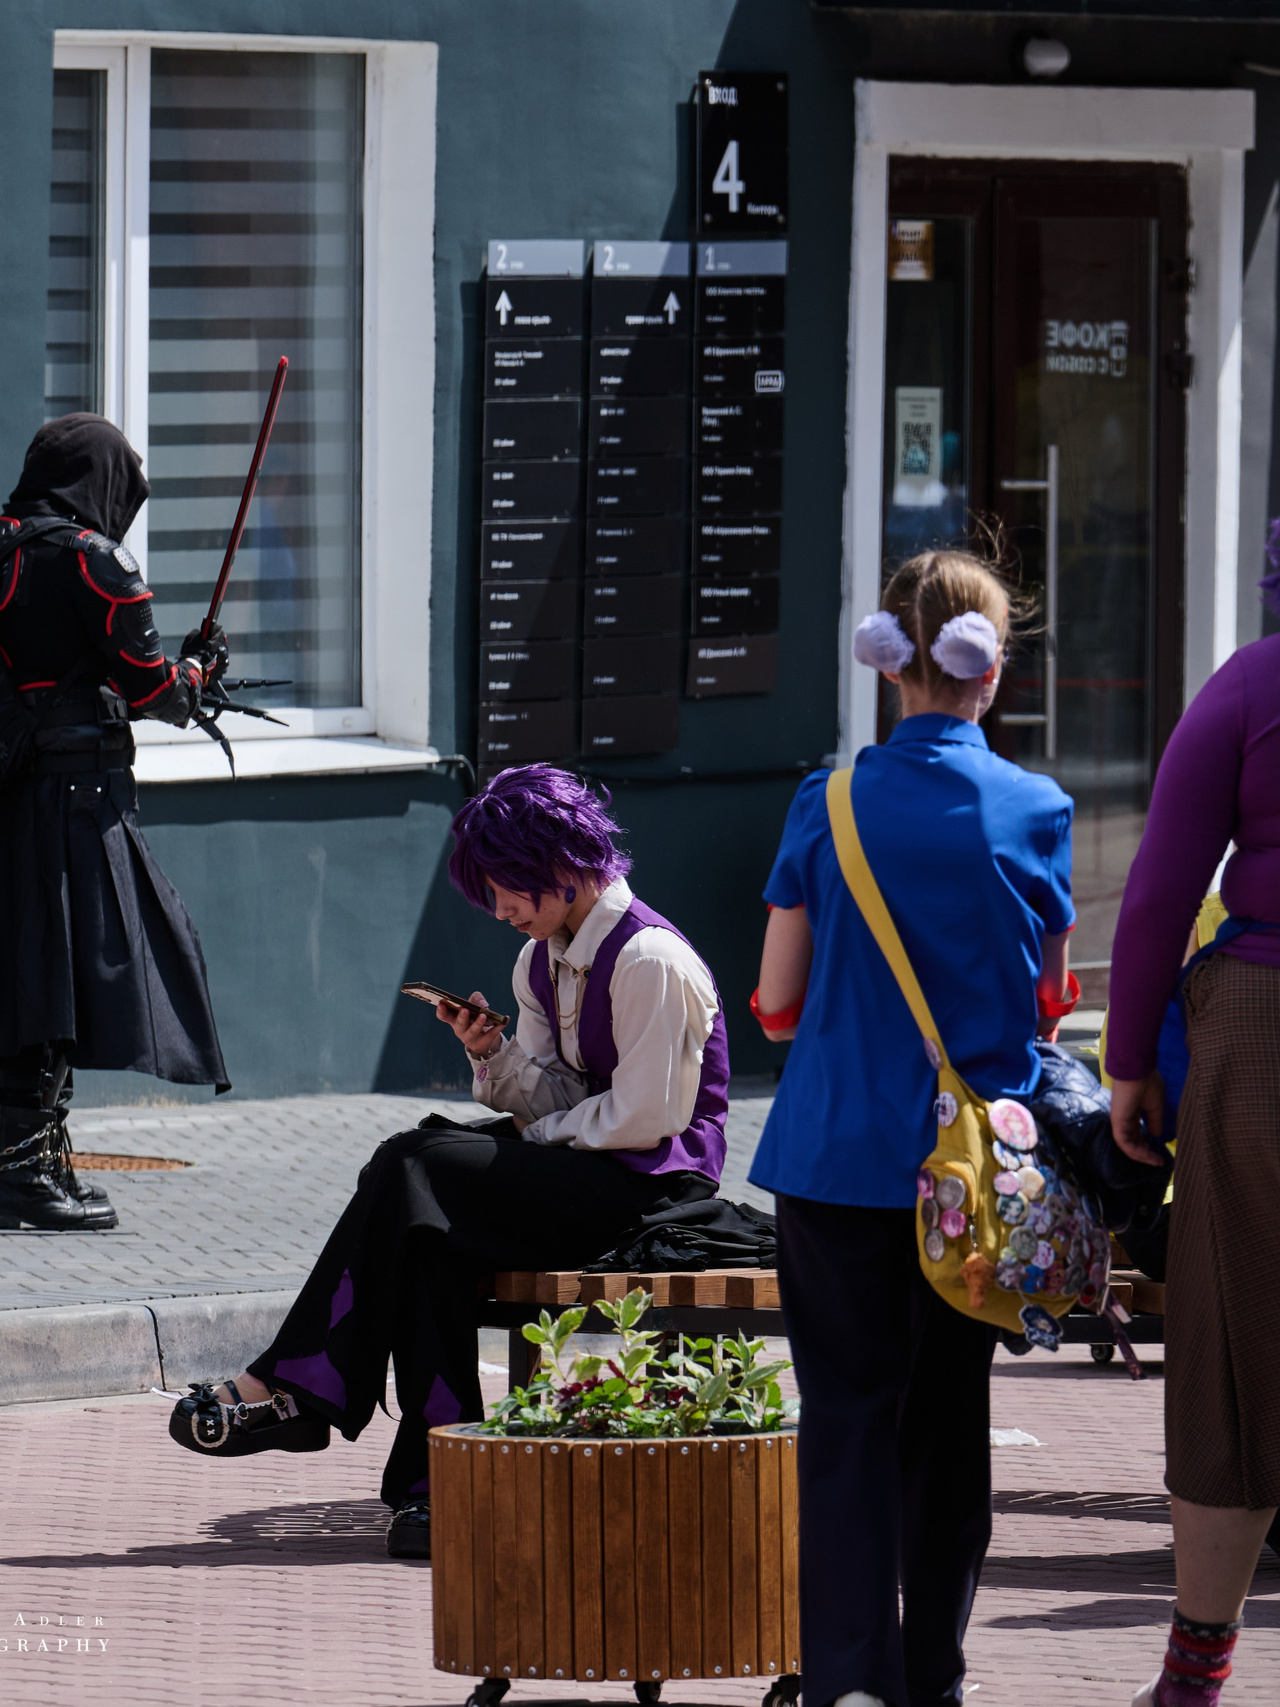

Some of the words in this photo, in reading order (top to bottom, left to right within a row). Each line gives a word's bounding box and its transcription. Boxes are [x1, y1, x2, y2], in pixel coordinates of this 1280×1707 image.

[712, 140, 745, 212] 4
[497, 244, 507, 270] 2
[603, 245, 614, 271] 2
[705, 246, 716, 271] 1
